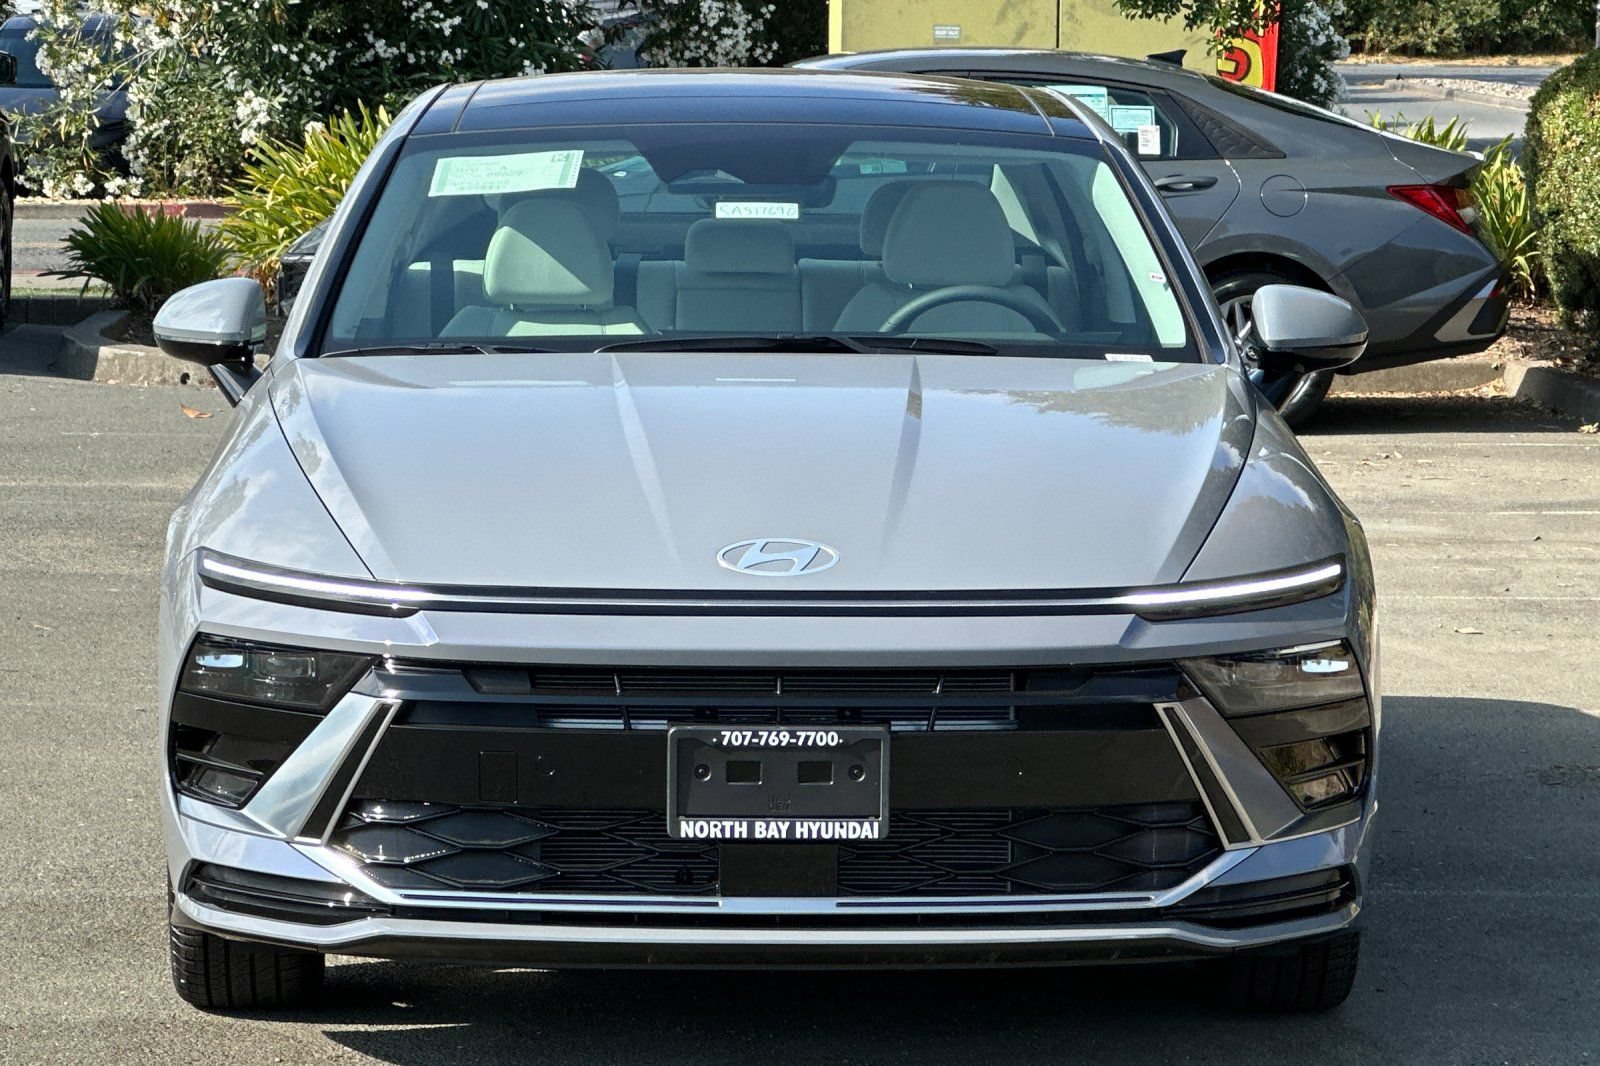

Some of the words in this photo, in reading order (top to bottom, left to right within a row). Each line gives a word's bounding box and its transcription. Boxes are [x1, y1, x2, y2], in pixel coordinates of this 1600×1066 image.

[720, 731, 839, 747] 707-769-7700
[680, 820, 748, 839] NORTH
[754, 820, 790, 839] BAY
[795, 820, 880, 839] HYUNDAI
